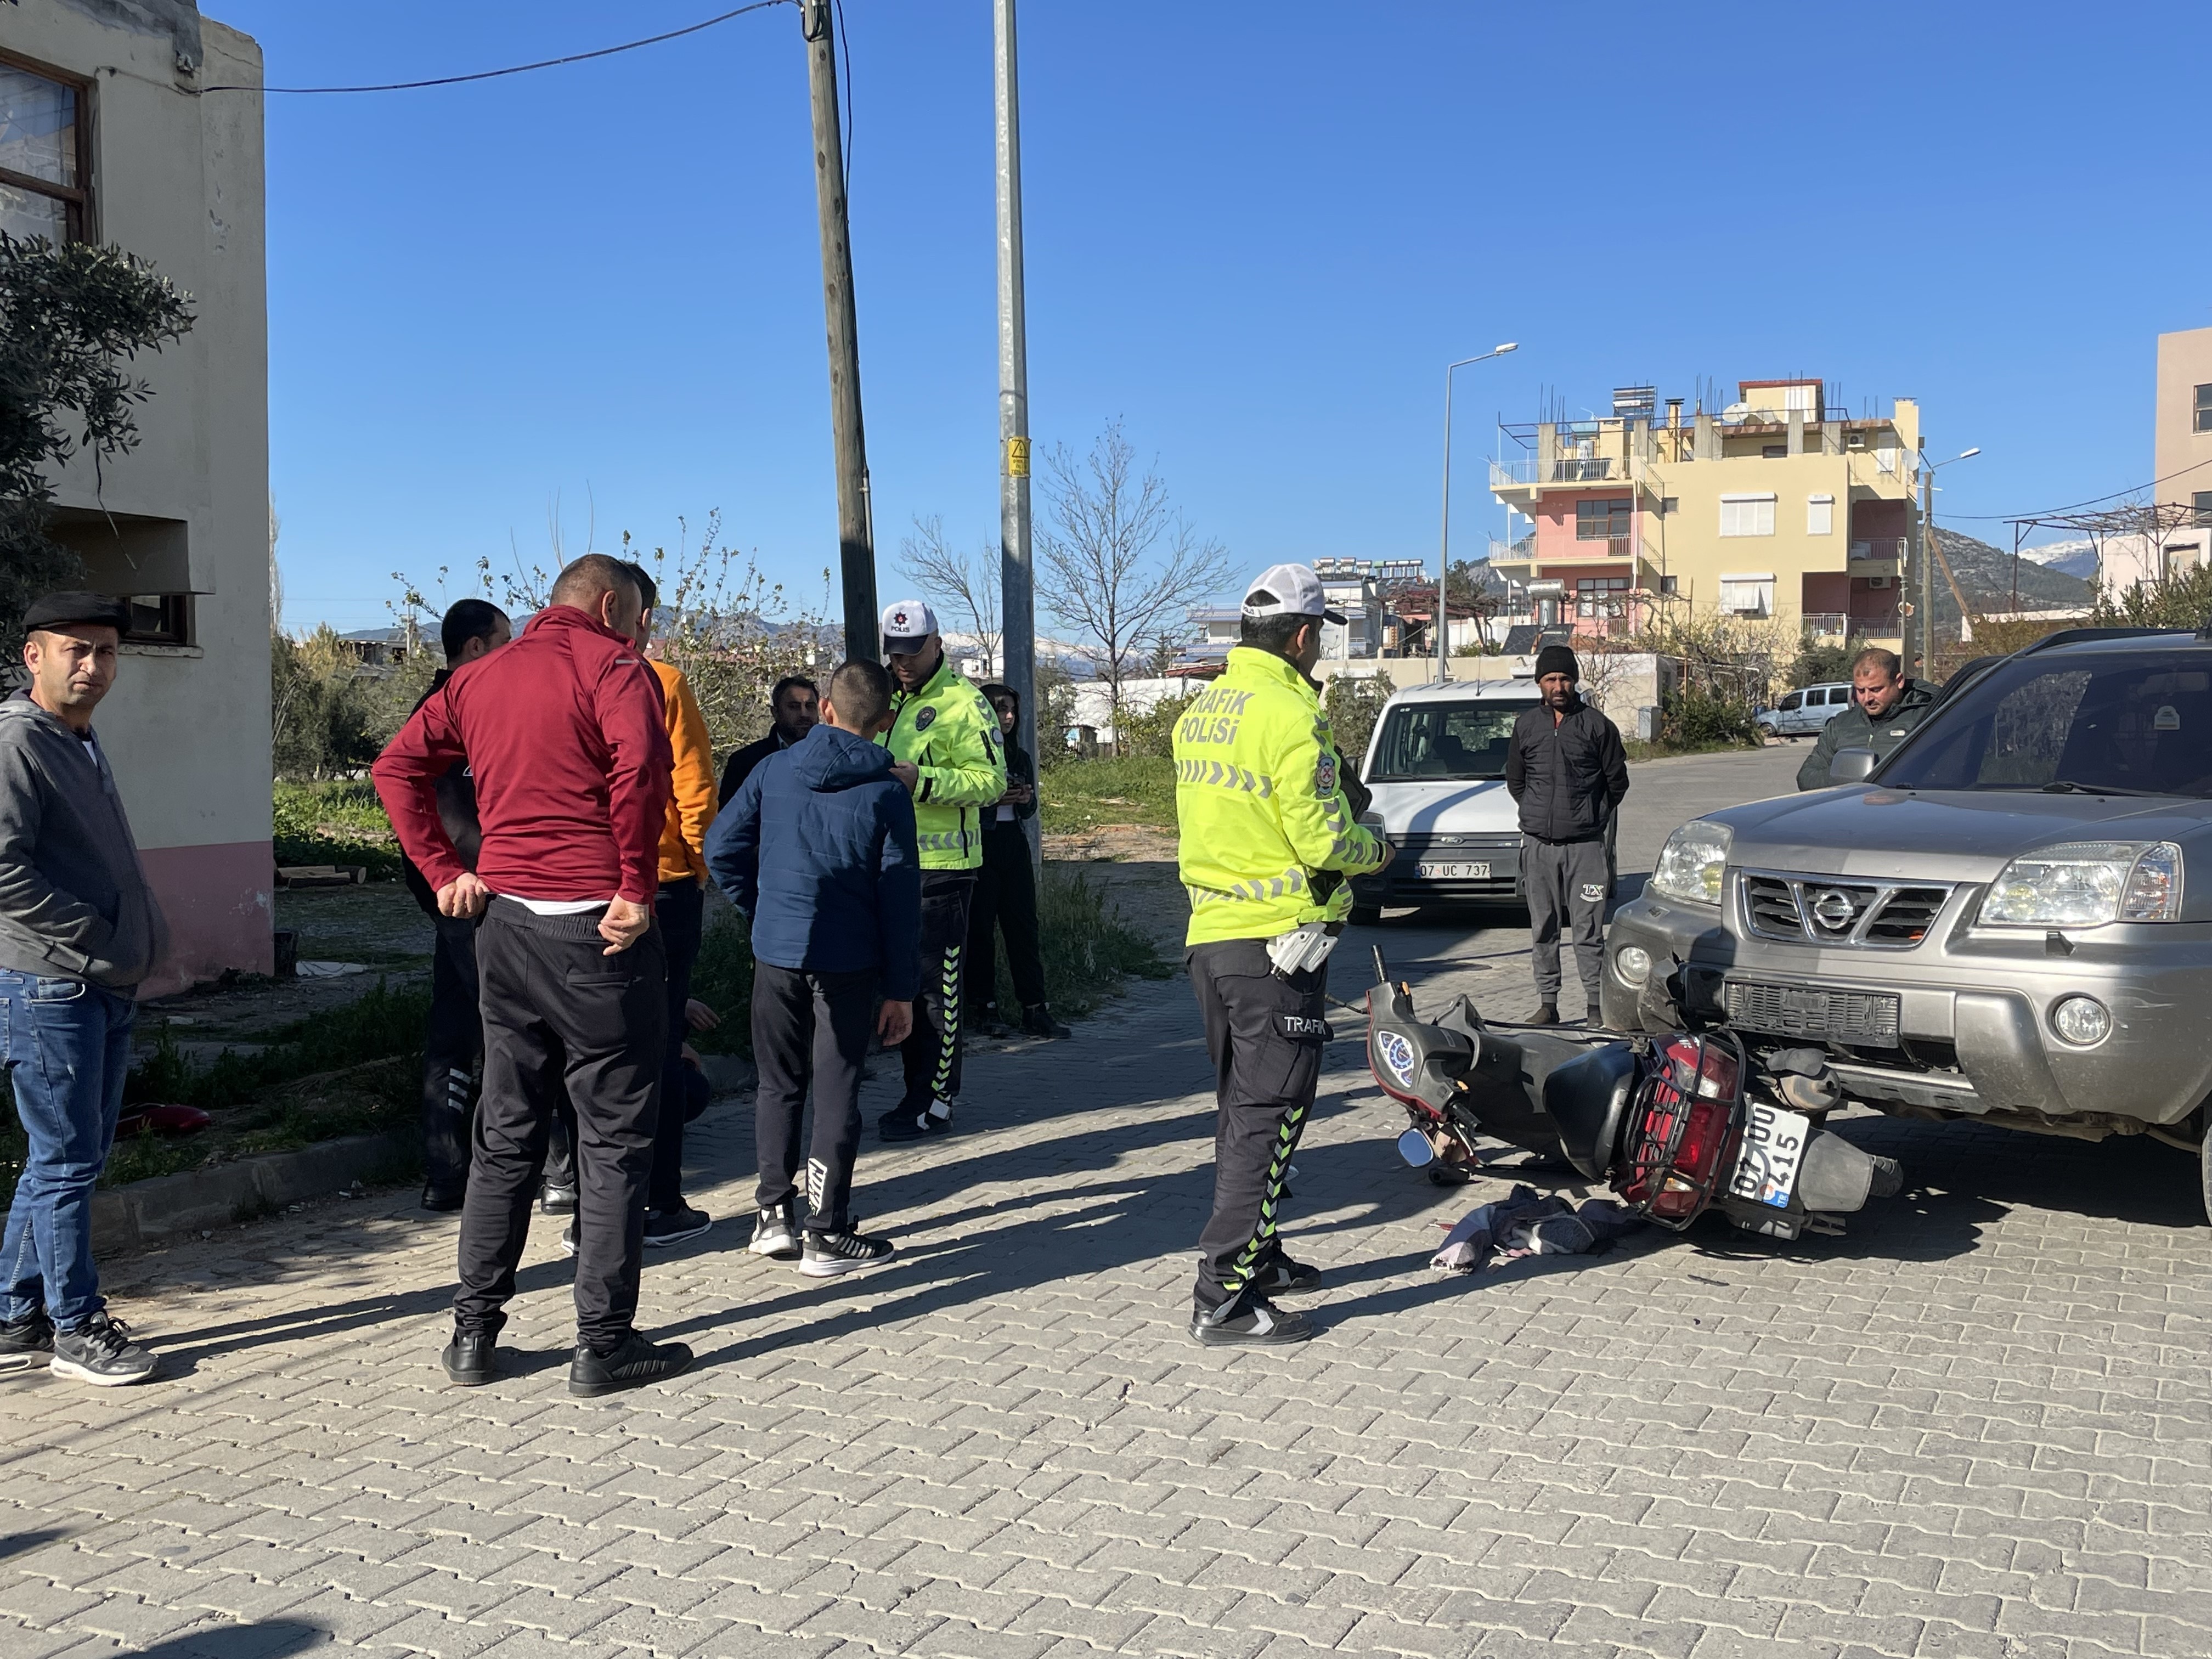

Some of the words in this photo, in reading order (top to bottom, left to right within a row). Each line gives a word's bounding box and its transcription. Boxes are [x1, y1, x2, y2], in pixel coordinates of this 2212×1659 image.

[1421, 865, 1435, 876] 07
[1443, 865, 1457, 876] UC
[1466, 865, 1487, 876] 737
[1734, 1157, 1760, 1193] 07
[1748, 1107, 1775, 1142] UU
[1768, 1133, 1798, 1186] 415
